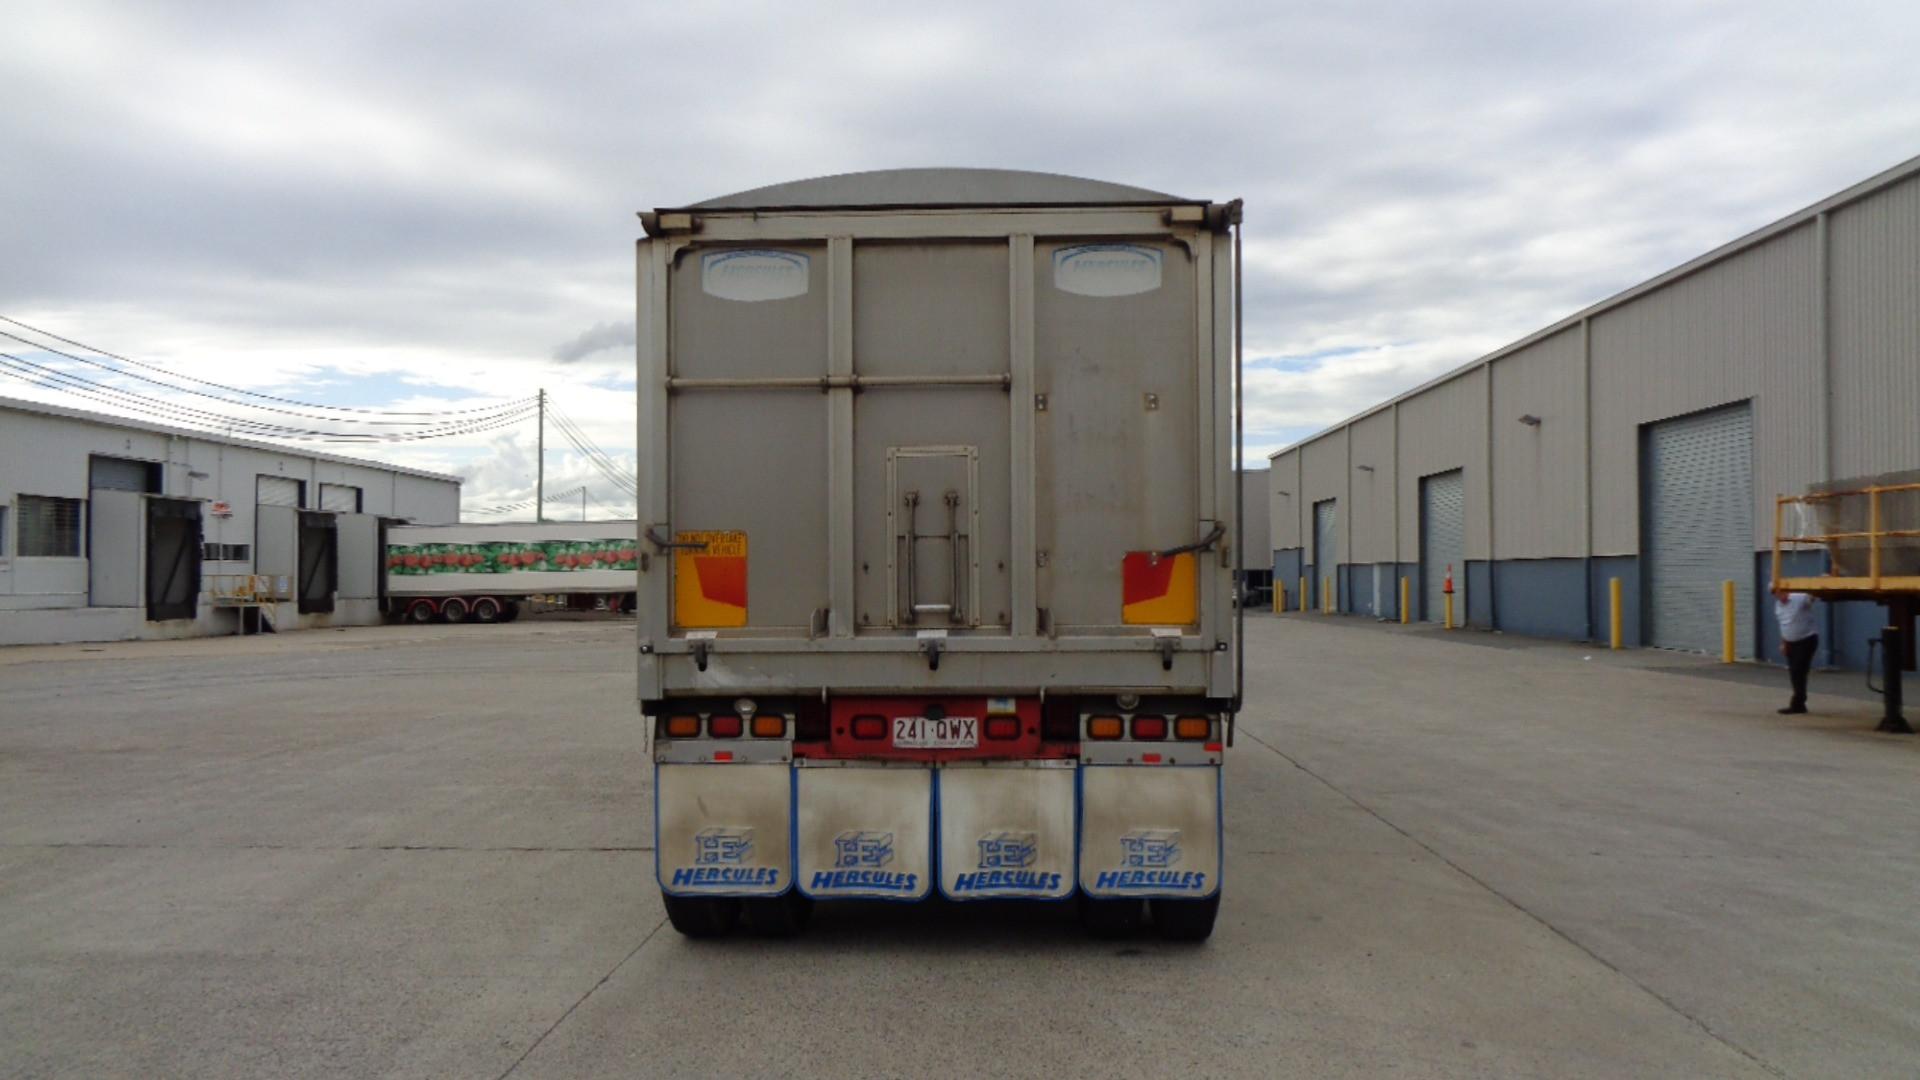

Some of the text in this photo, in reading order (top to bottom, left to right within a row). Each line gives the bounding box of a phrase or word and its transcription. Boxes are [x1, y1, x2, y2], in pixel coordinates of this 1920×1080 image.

[672, 867, 779, 886] HERCULES
[811, 871, 918, 891] HERCULES
[954, 870, 1062, 891] HERCULES
[1096, 871, 1206, 889] HERCULES
